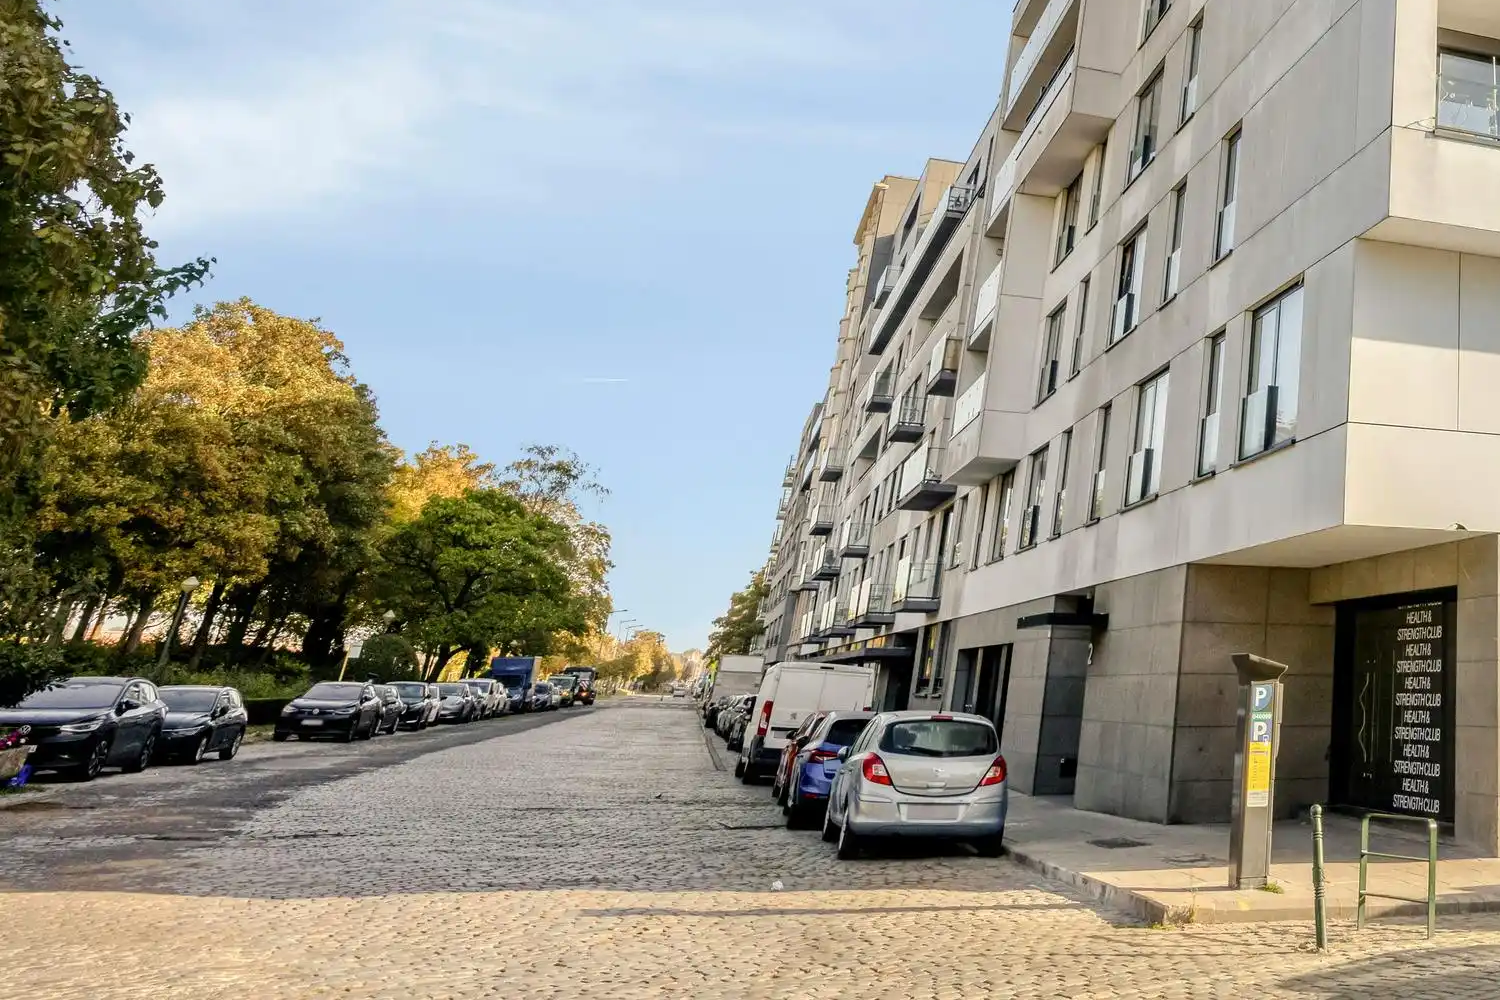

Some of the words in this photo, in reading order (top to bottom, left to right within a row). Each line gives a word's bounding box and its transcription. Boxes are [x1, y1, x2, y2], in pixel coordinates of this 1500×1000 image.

[1406, 611, 1427, 624] HEALTH
[1397, 628, 1426, 640] STRENGTH
[1426, 625, 1442, 639] CLUB
[1405, 643, 1427, 656] HEALTH
[1396, 660, 1425, 673] STRENGTH
[1425, 659, 1441, 672] CLUB
[1404, 676, 1426, 689] HEALTH
[1255, 687, 1267, 707] P
[1395, 693, 1425, 706] STRENGTH
[1425, 693, 1441, 706] CLUB
[1403, 710, 1425, 723] HEALTH
[1253, 721, 1267, 741] P
[1394, 726, 1424, 740] STRENGTH
[1424, 728, 1441, 741] CLUB
[1403, 744, 1425, 757] HEALTH
[1393, 760, 1424, 775] STRENGTH
[1424, 762, 1440, 777] CLUB
[1402, 778, 1424, 792] HEALTH
[1392, 794, 1423, 811] STRENGTH
[1423, 798, 1440, 813] CLUB
